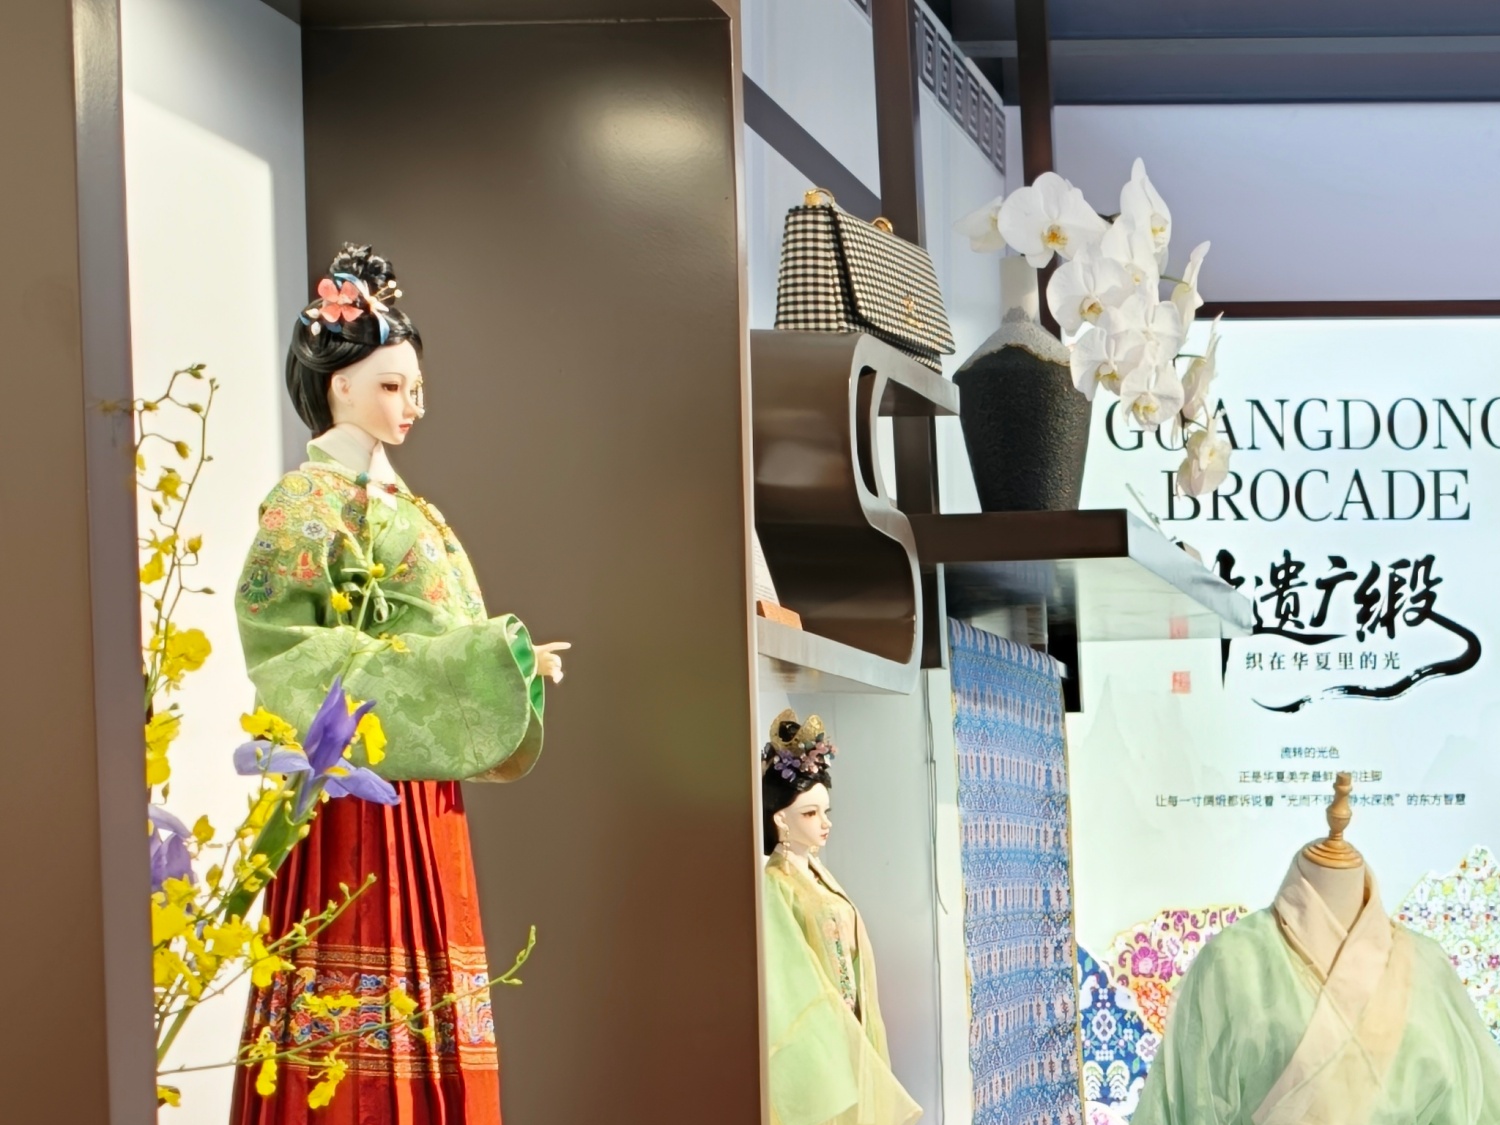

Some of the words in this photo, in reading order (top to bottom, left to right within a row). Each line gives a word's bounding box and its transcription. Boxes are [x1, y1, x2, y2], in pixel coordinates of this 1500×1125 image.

[1160, 469, 1471, 522] BROCADE
[1245, 650, 1401, 672] 织在华夏里的光
[1280, 746, 1340, 760] 流转的光色
[1239, 770, 1383, 784] 正是华夏美学最鲜的注脚
